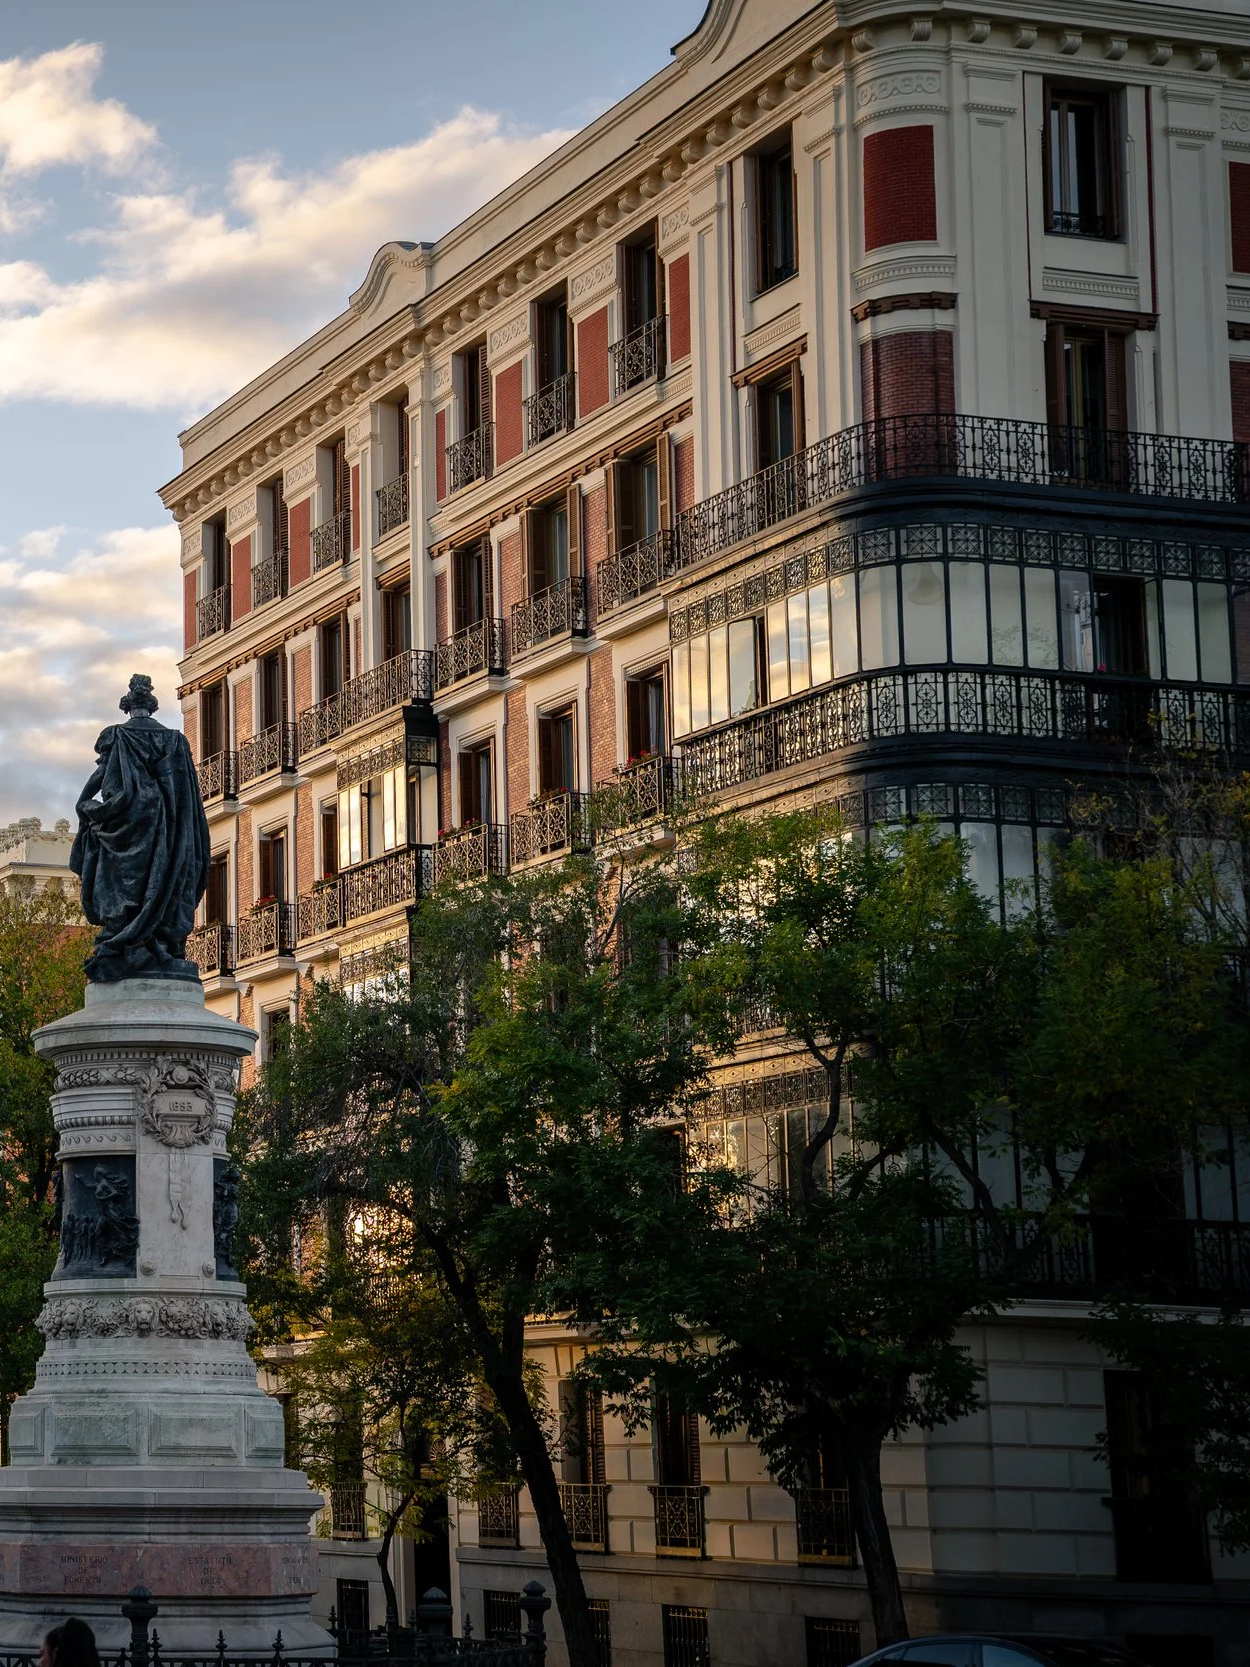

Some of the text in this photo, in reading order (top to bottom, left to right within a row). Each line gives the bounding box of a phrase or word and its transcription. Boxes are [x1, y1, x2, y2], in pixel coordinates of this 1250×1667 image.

[168, 1101, 193, 1112] 1893
[78, 1566, 91, 1575] DE
[203, 1567, 215, 1575] DE
